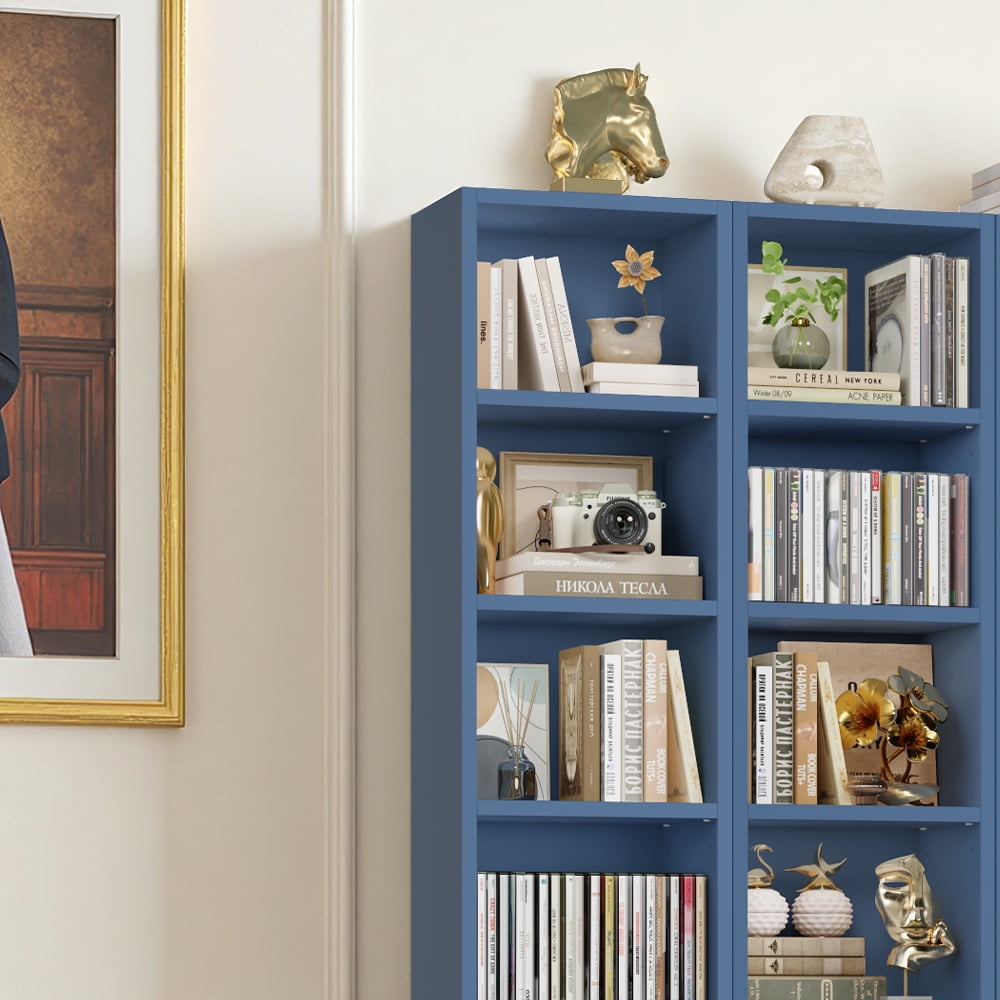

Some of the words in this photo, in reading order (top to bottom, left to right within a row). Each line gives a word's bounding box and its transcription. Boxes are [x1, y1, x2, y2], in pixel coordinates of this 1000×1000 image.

[480, 320, 488, 344] lines.
[795, 373, 839, 384] CEREAL
[873, 393, 893, 401] PAPER
[556, 580, 615, 593] НИКОЛА
[620, 581, 668, 595] ТЕСЛА
[645, 652, 656, 703] CHAPMAN
[796, 664, 807, 711] CHAPMAN
[809, 673, 817, 703] CALLUM
[624, 647, 642, 740] ПАСТЕРНАК
[776, 659, 793, 741] ПАСТЕРНАК
[624, 744, 642, 794] БОРИС
[646, 760, 654, 782] TUTS+
[656, 748, 665, 772] BOOK
[808, 753, 816, 774] BOOK
[657, 772, 666, 794] COVER
[776, 748, 793, 797] БОРИС
[798, 764, 806, 785] TUTS+
[808, 775, 816, 797] COVER
